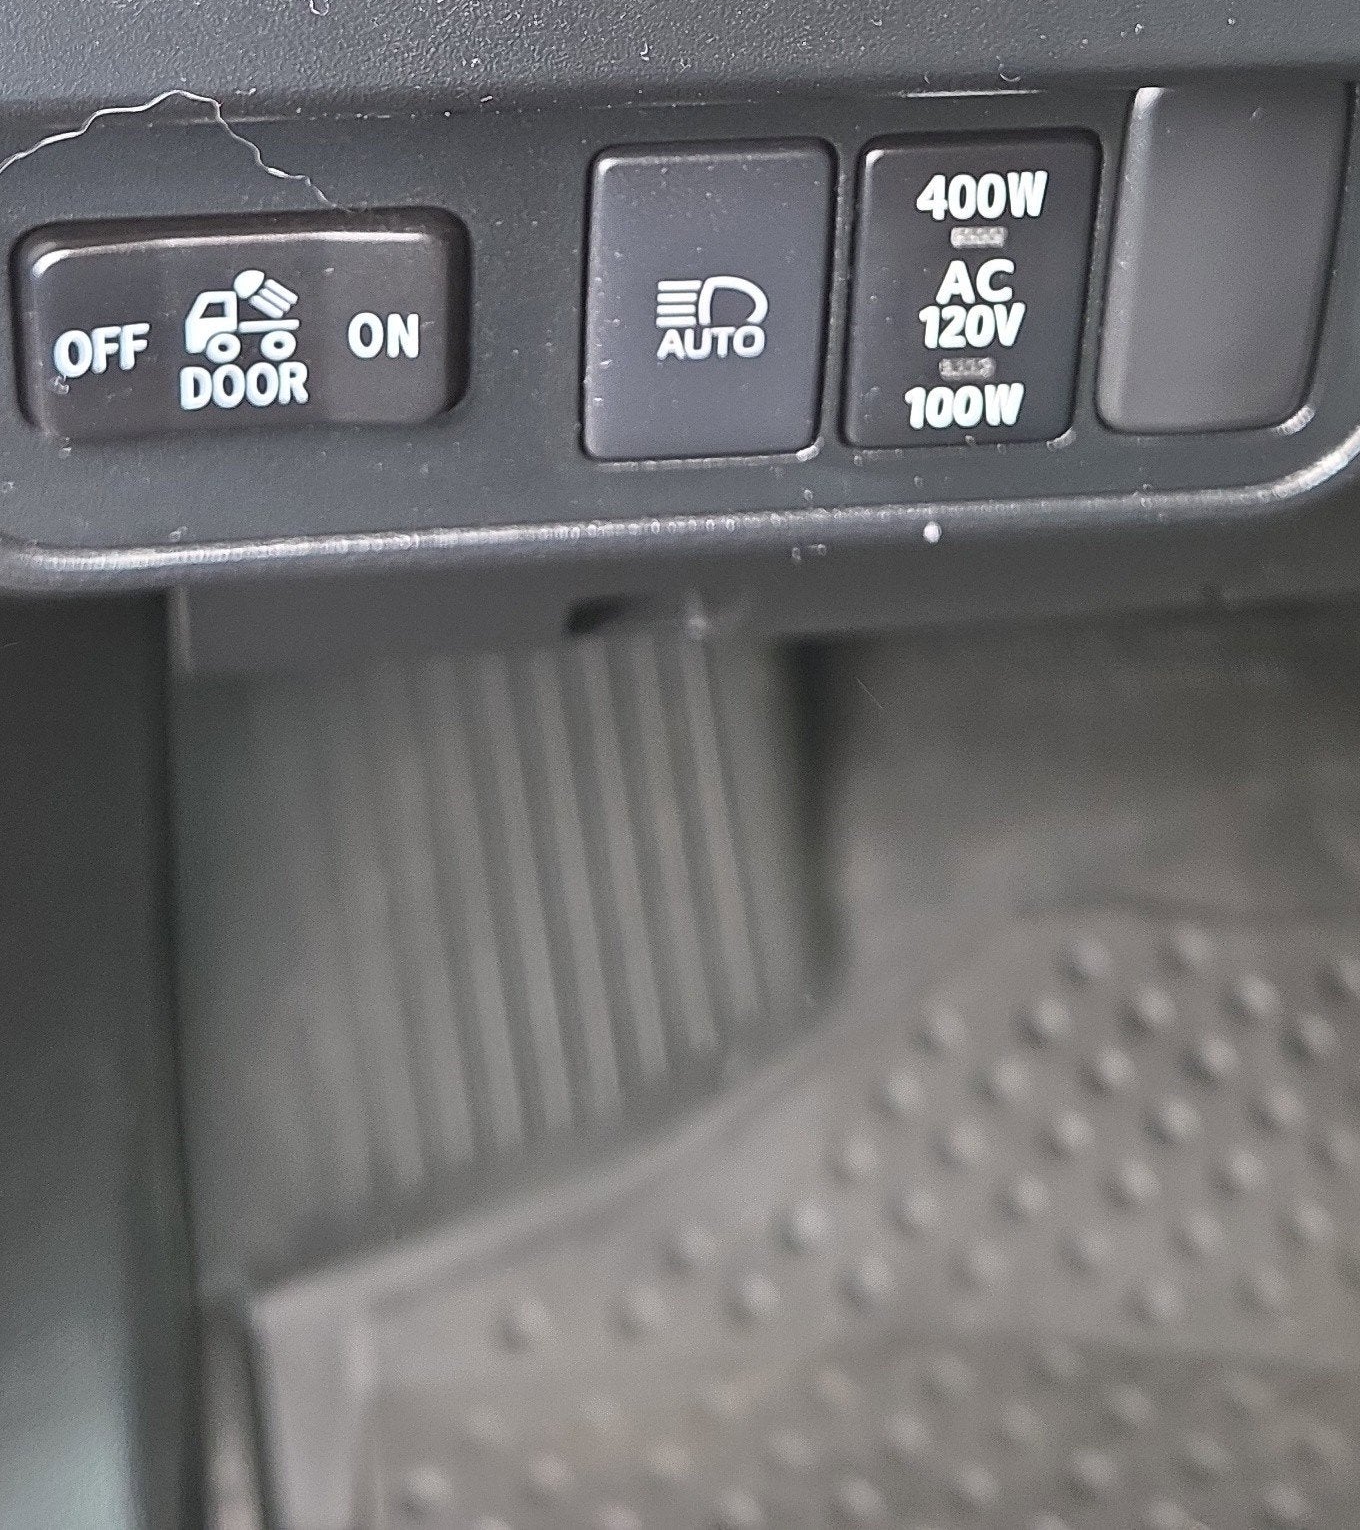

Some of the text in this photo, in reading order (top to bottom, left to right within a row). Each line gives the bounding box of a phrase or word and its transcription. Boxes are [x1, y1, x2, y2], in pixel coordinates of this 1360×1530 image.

[916, 170, 1048, 220] 400W
[936, 258, 1015, 304] AC
[53, 312, 420, 378] OFF ON
[656, 325, 766, 360] AUTO
[918, 301, 1026, 349] 120V
[180, 361, 309, 411] DOOR
[904, 382, 1025, 429] 100W
